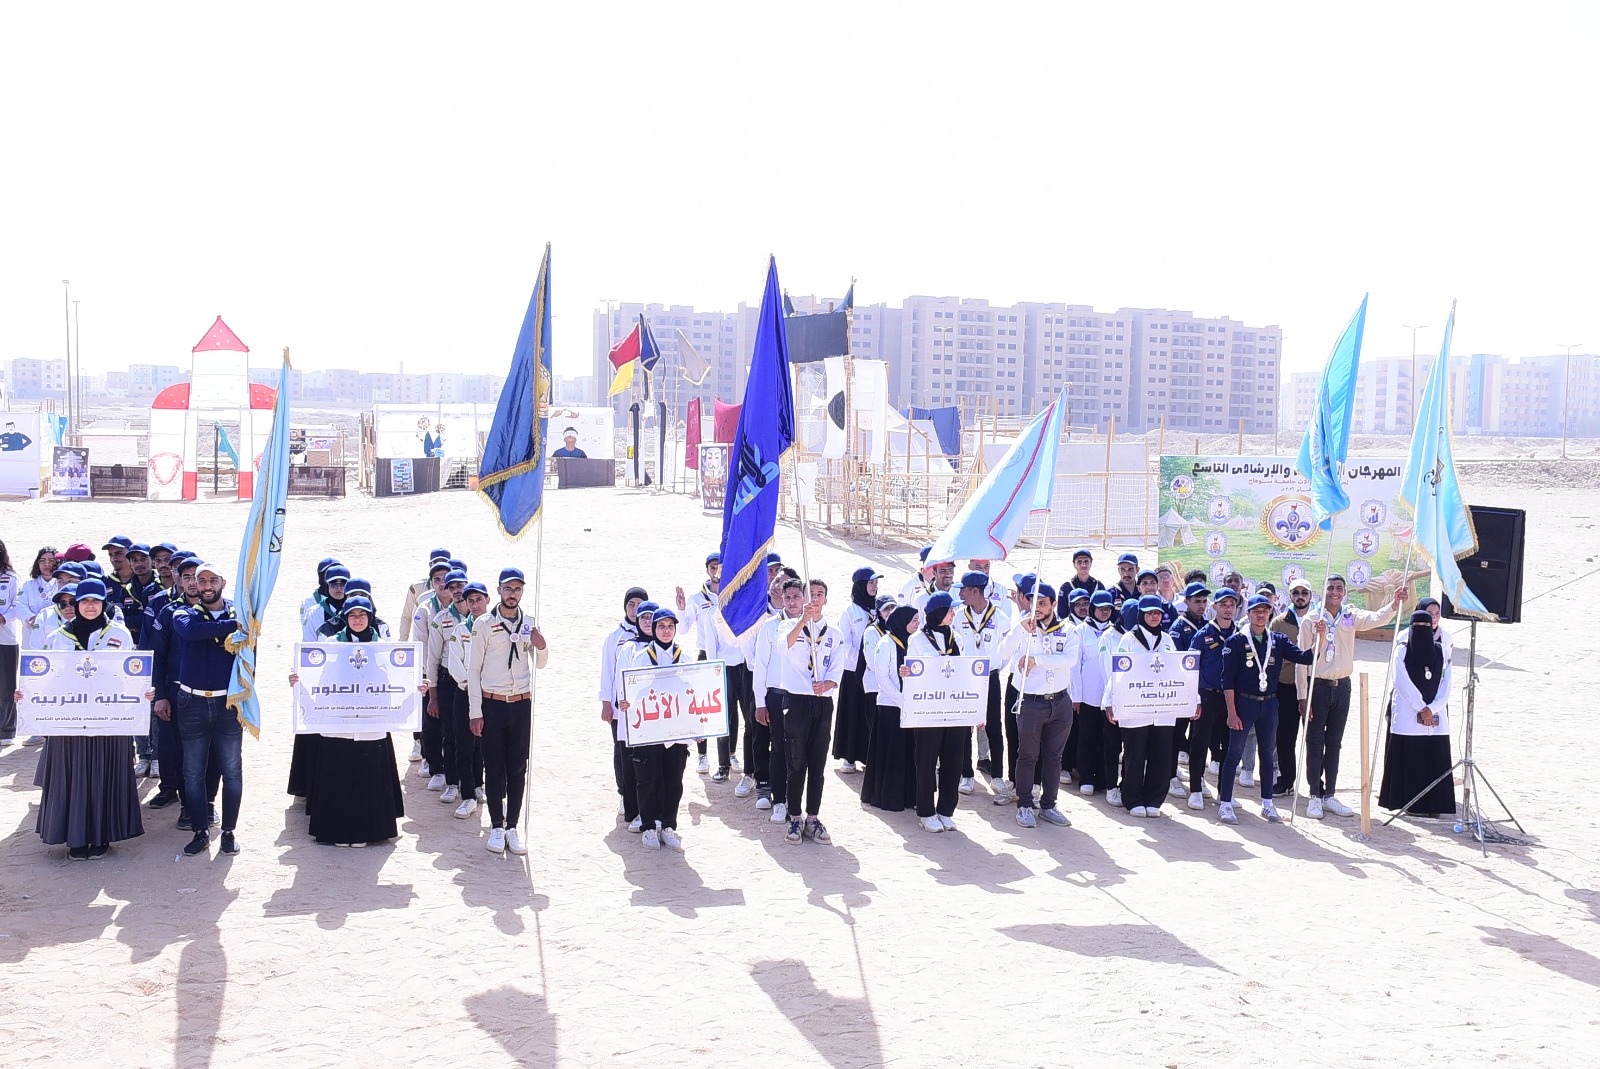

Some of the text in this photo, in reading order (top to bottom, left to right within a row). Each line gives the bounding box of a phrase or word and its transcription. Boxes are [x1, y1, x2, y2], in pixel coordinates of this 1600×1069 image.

[1192, 462, 1229, 477] التاسع
[1348, 465, 1401, 480] المهرجان
[311, 682, 406, 697] كلية العلوم
[1128, 679, 1185, 689] كلية علوم
[30, 692, 141, 707] كلية التربية
[949, 690, 980, 702] كلية
[1140, 690, 1177, 700] الرياضة
[631, 688, 722, 730] كلية الآثار
